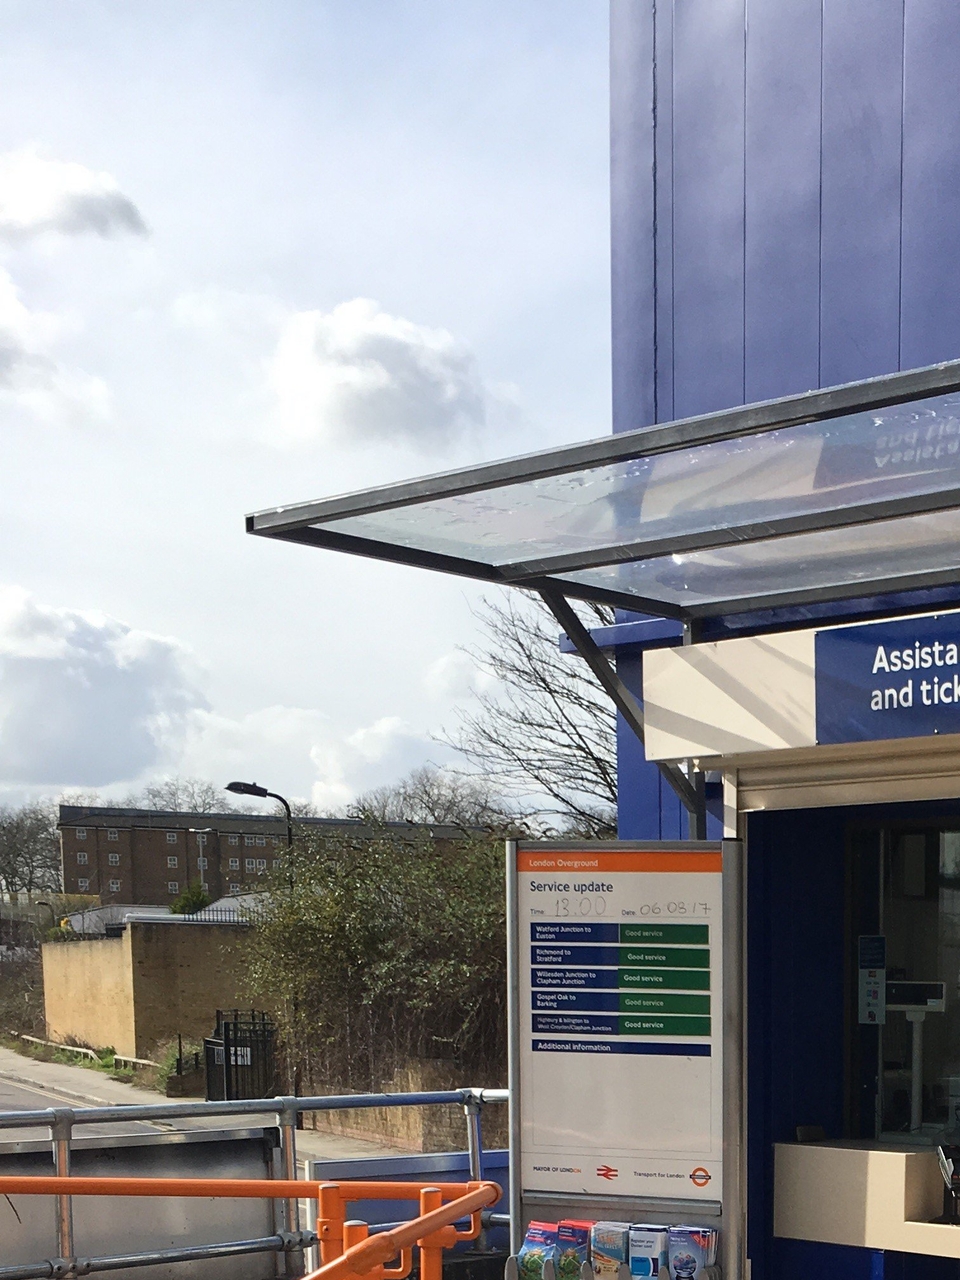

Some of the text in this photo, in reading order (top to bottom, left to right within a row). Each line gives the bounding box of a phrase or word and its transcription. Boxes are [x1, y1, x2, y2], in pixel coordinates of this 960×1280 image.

[870, 679, 913, 711] and
[529, 859, 598, 868] London Overground
[530, 880, 614, 894] Service update
[537, 1000, 557, 1008] Barking
[538, 1042, 571, 1050] Additional
